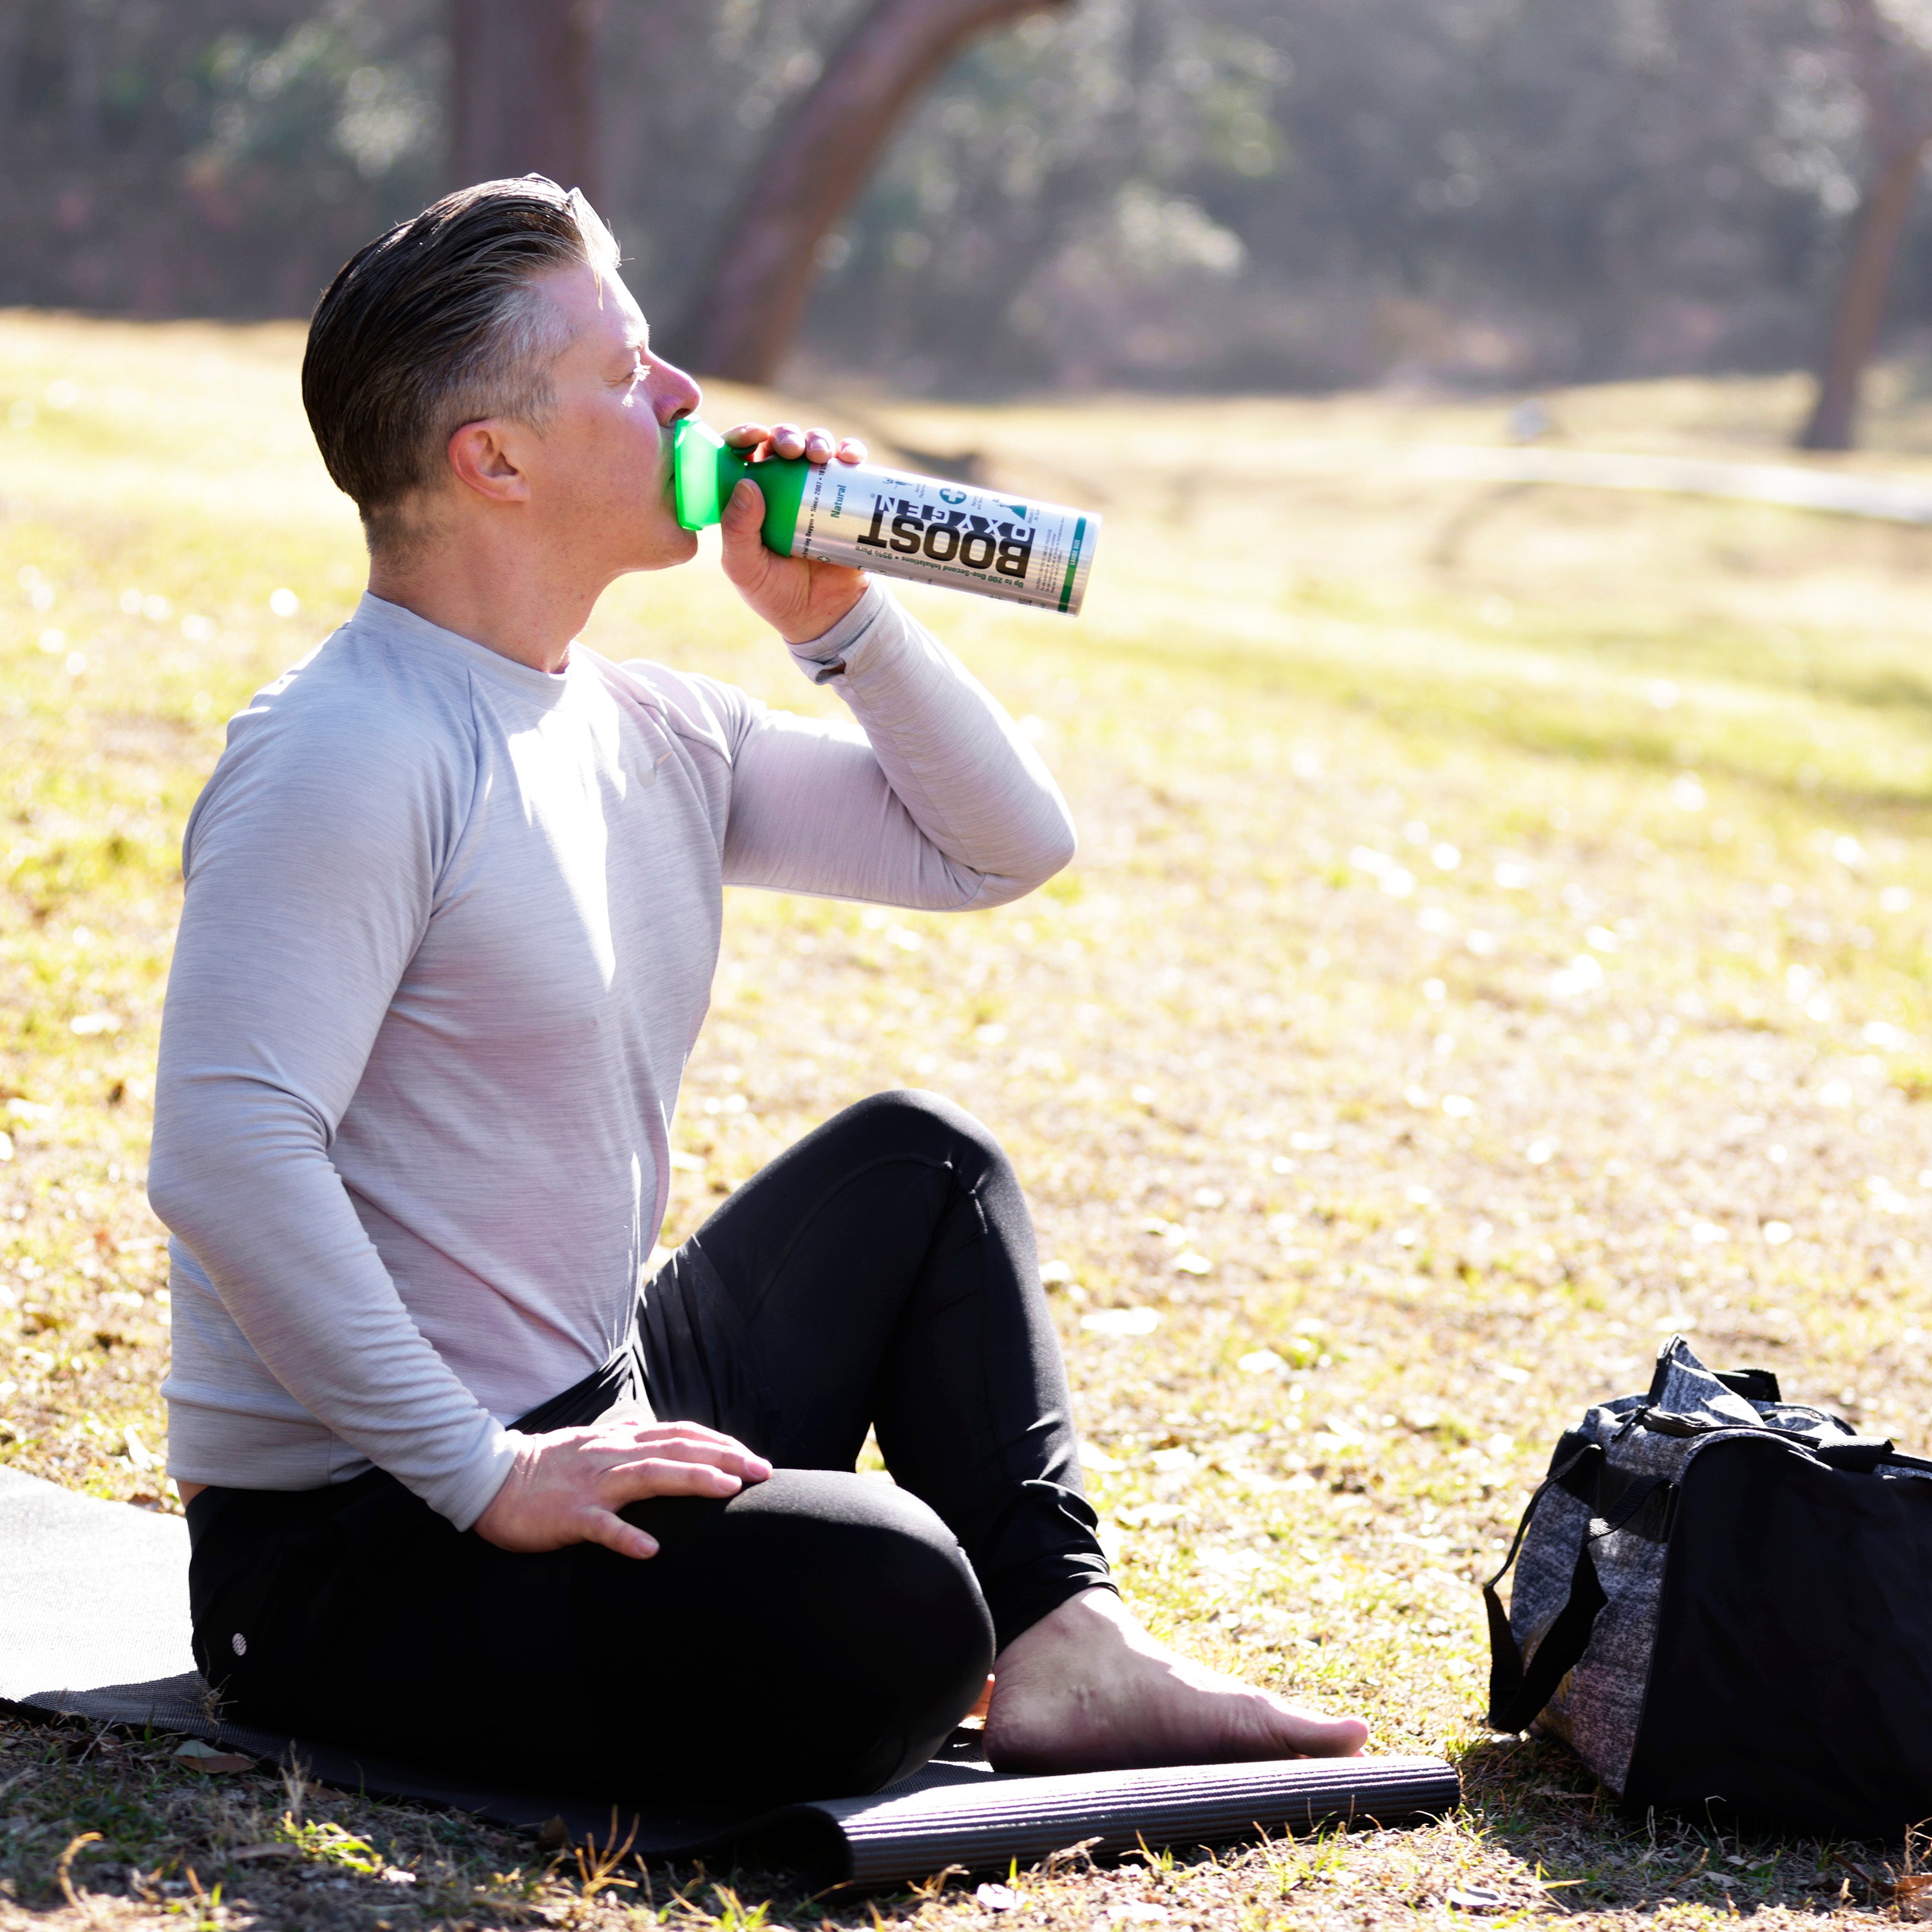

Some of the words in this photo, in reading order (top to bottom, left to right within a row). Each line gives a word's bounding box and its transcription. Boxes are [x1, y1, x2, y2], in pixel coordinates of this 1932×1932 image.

[830, 484, 846, 518] Natural
[878, 495, 1031, 542] OXYGEN
[805, 518, 815, 537] Oxygen
[855, 545, 873, 555] Pure
[857, 509, 1032, 578] BOOST
[873, 550, 893, 560] 95%
[1070, 550, 1078, 565] LARGE
[901, 556, 942, 571] Inhalations
[942, 565, 987, 580] One-Second
[988, 575, 1003, 583] 200
[1014, 580, 1024, 588] Up
